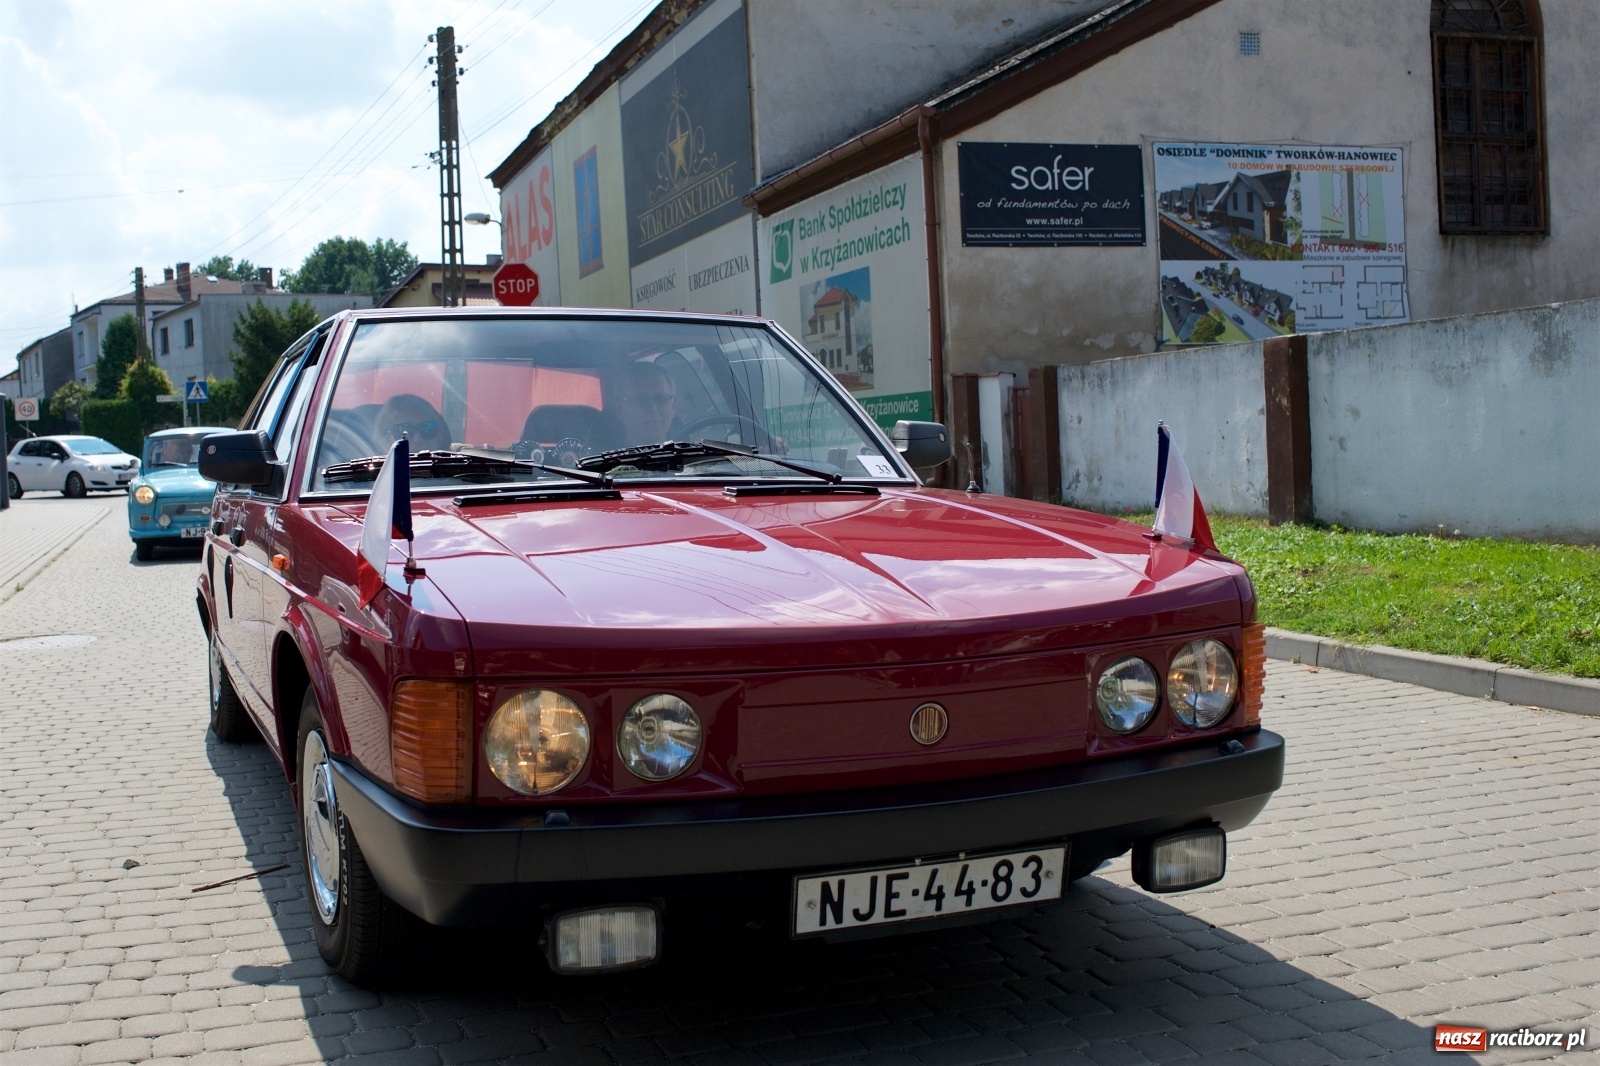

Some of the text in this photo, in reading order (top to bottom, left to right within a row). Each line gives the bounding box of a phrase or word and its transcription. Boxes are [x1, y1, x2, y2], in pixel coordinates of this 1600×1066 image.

[1157, 147, 1207, 157] OSIEDLE
[1275, 149, 1397, 161] TWORKÓW-HANOWIEC
[1010, 154, 1094, 191] safer
[1227, 162, 1237, 170] 10
[1240, 162, 1274, 171] DOMÓW
[1339, 164, 1395, 173] SZEREGOWEJ
[640, 169, 734, 242] STAR CONSULTING
[799, 183, 907, 241] Bank Spółdzielczy
[976, 197, 1130, 212] od fundamentów po dach
[1025, 217, 1083, 227] www.safer.pl
[800, 217, 911, 274] w Krzyżanowicach
[1387, 243, 1404, 253] 516
[688, 254, 750, 291] UBEZPIECZENIA
[498, 279, 535, 294] STOP
[636, 268, 677, 303] KSIĘGOWOŚĆ
[21, 405, 33, 413] 40
[875, 464, 891, 475] 33
